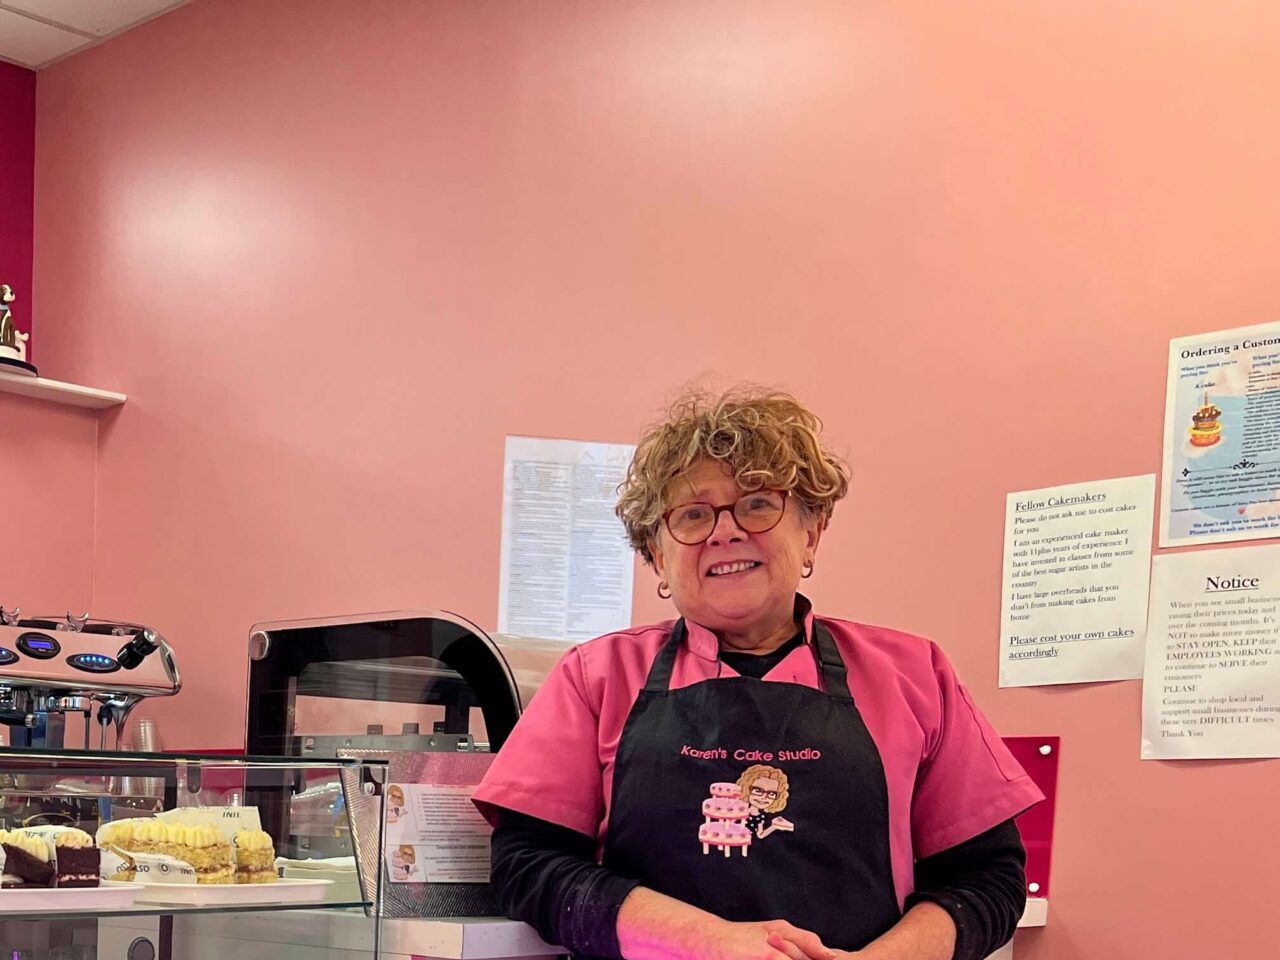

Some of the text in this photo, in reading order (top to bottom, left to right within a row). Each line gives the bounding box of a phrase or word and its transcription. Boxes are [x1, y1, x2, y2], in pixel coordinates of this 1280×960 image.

[1181, 346, 1230, 358] Ordering
[1015, 492, 1106, 511] Fellow Cakemakers
[1015, 516, 1036, 524] Please
[1038, 514, 1047, 522] do
[1049, 512, 1060, 520] not
[1089, 507, 1097, 515] to
[1042, 532, 1083, 544] experienced
[1085, 530, 1102, 538] cake
[1104, 528, 1128, 536] maker
[1053, 545, 1070, 553] years
[1072, 542, 1080, 550] of
[1082, 540, 1122, 550] experience
[1048, 566, 1066, 575] sugar
[1206, 574, 1260, 590] Notice
[1016, 592, 1032, 600] have
[1051, 588, 1087, 596] overheads
[1010, 602, 1029, 611] don't
[1010, 636, 1038, 645] Please
[1108, 627, 1135, 636] cakes
[1009, 646, 1059, 658] accordingly
[1163, 685, 1196, 693] PLEASE
[681, 744, 727, 760] Karen's
[734, 749, 773, 761] Cake
